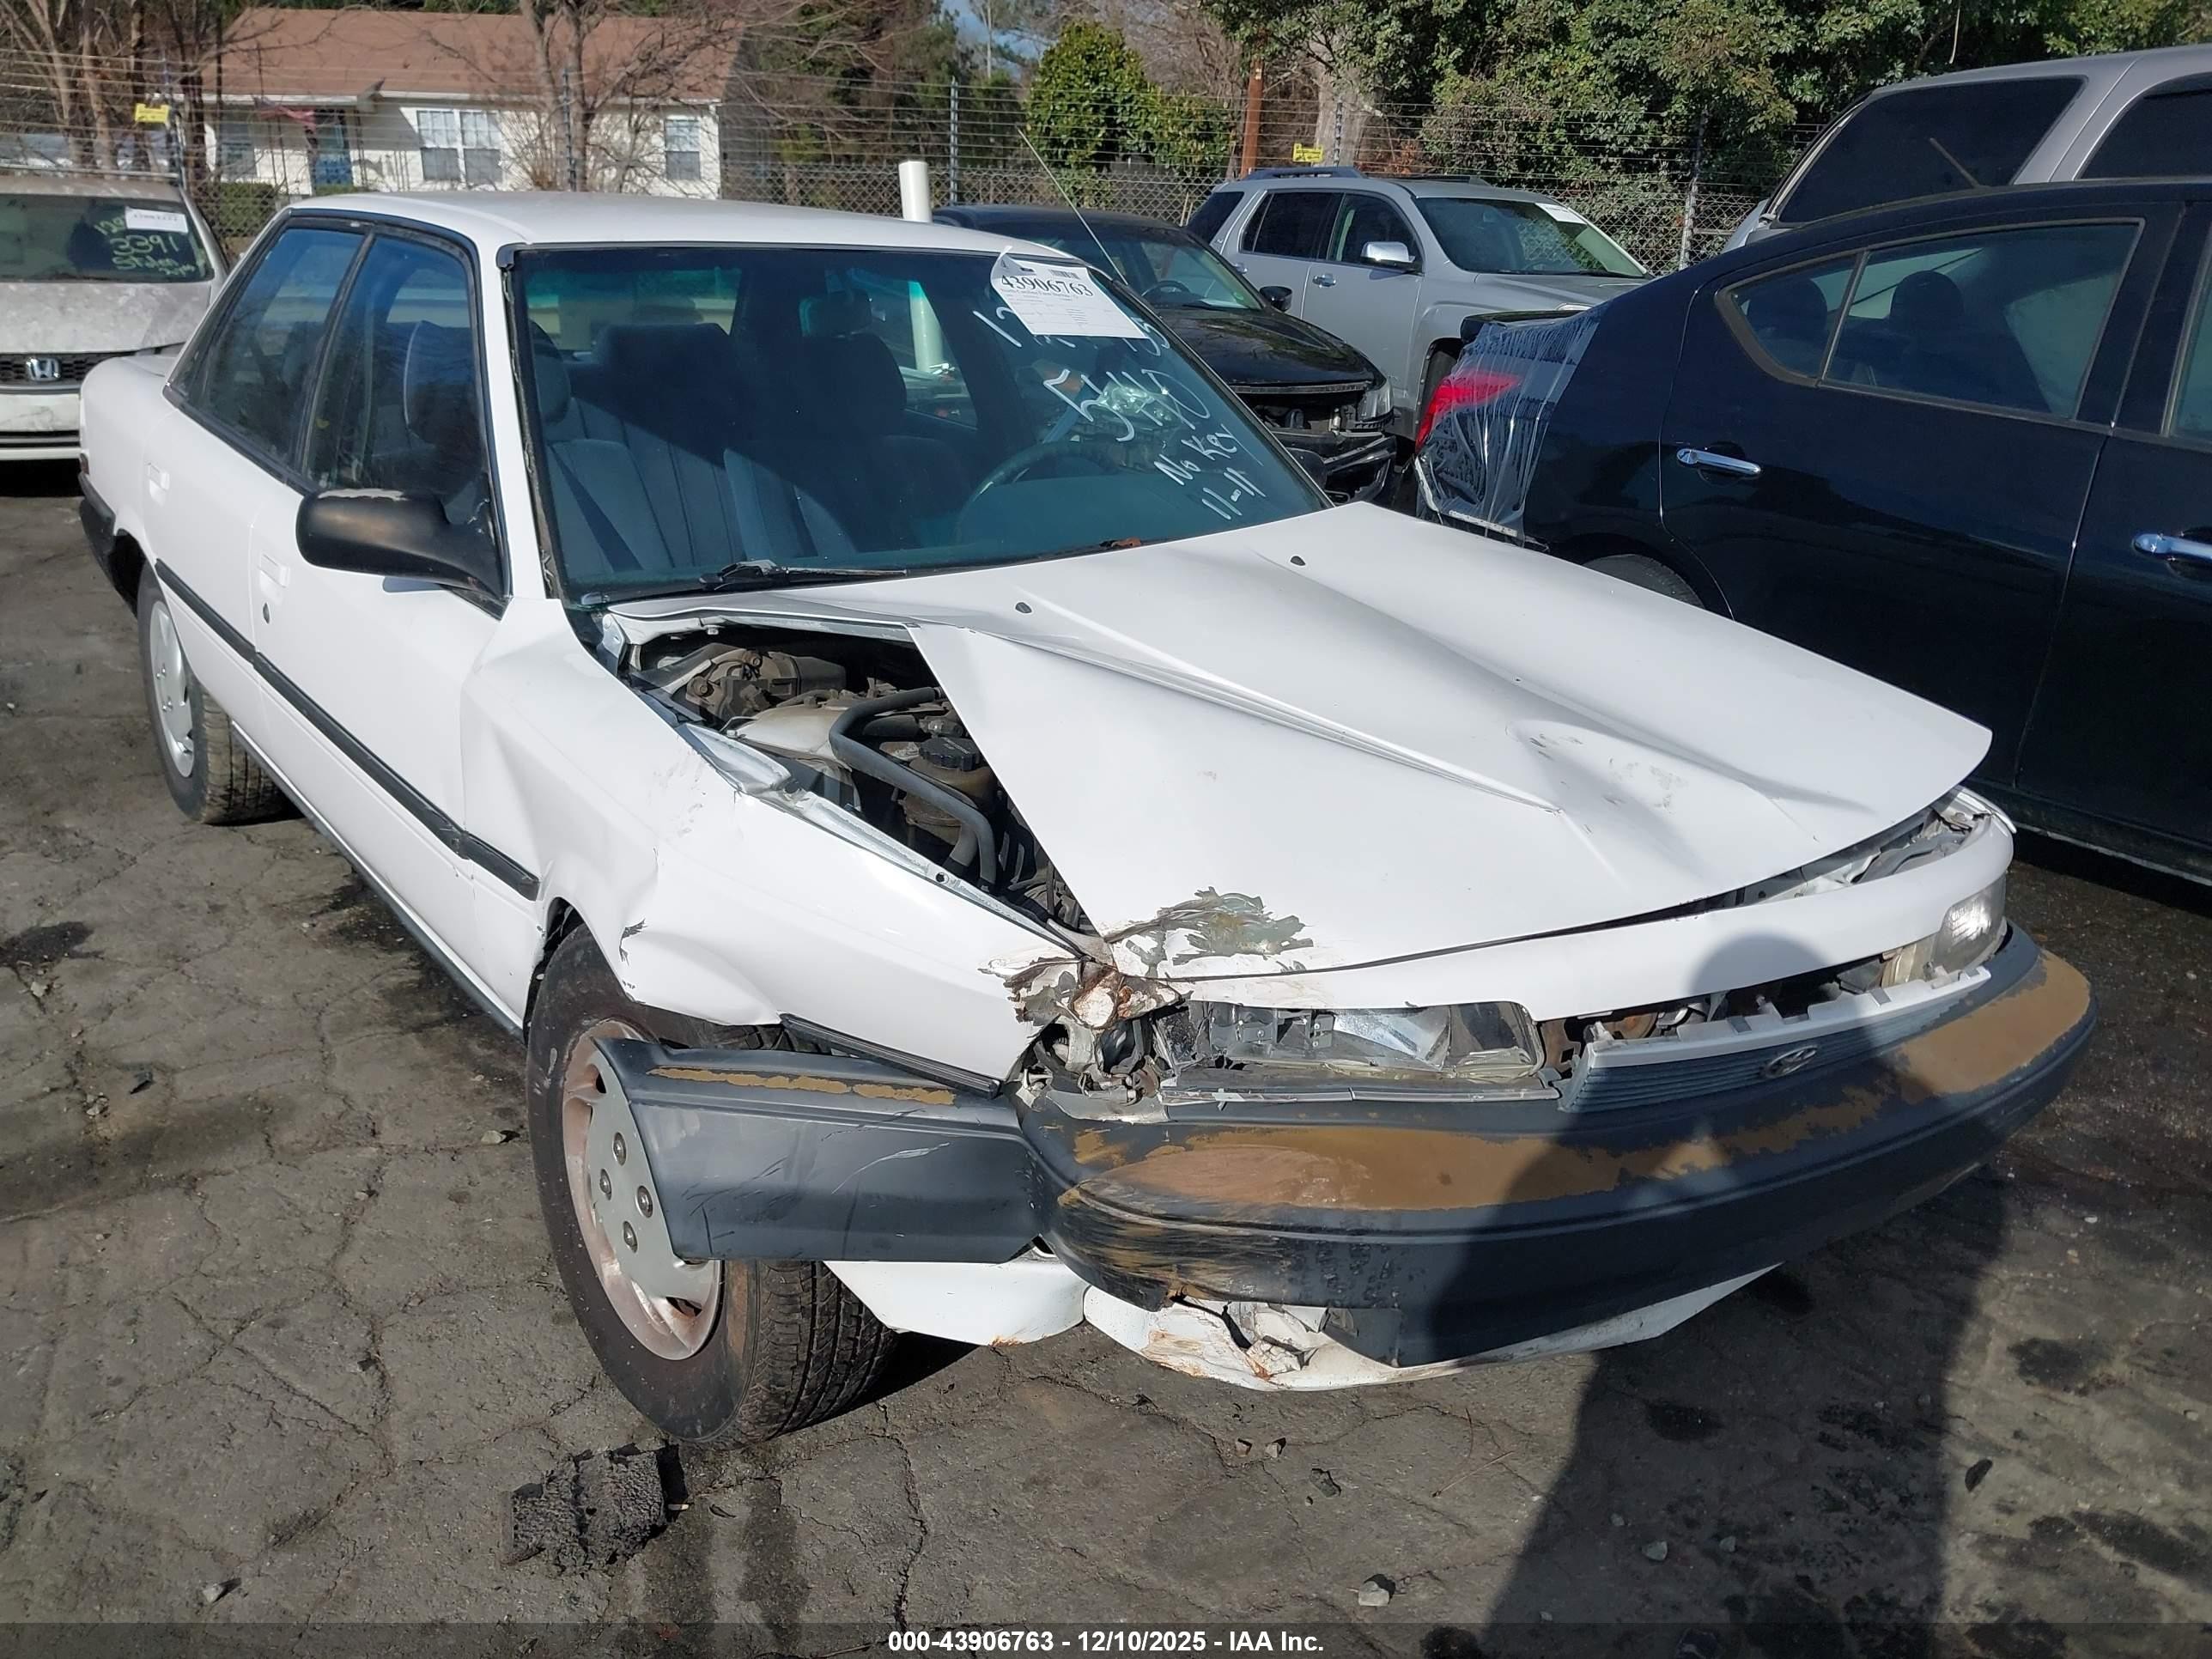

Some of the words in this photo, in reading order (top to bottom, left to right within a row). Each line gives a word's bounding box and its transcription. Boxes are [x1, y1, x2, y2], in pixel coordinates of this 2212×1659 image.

[1000, 274, 1094, 297] 43906763
[1153, 453, 1201, 485] No
[1180, 423, 1265, 466] Key
